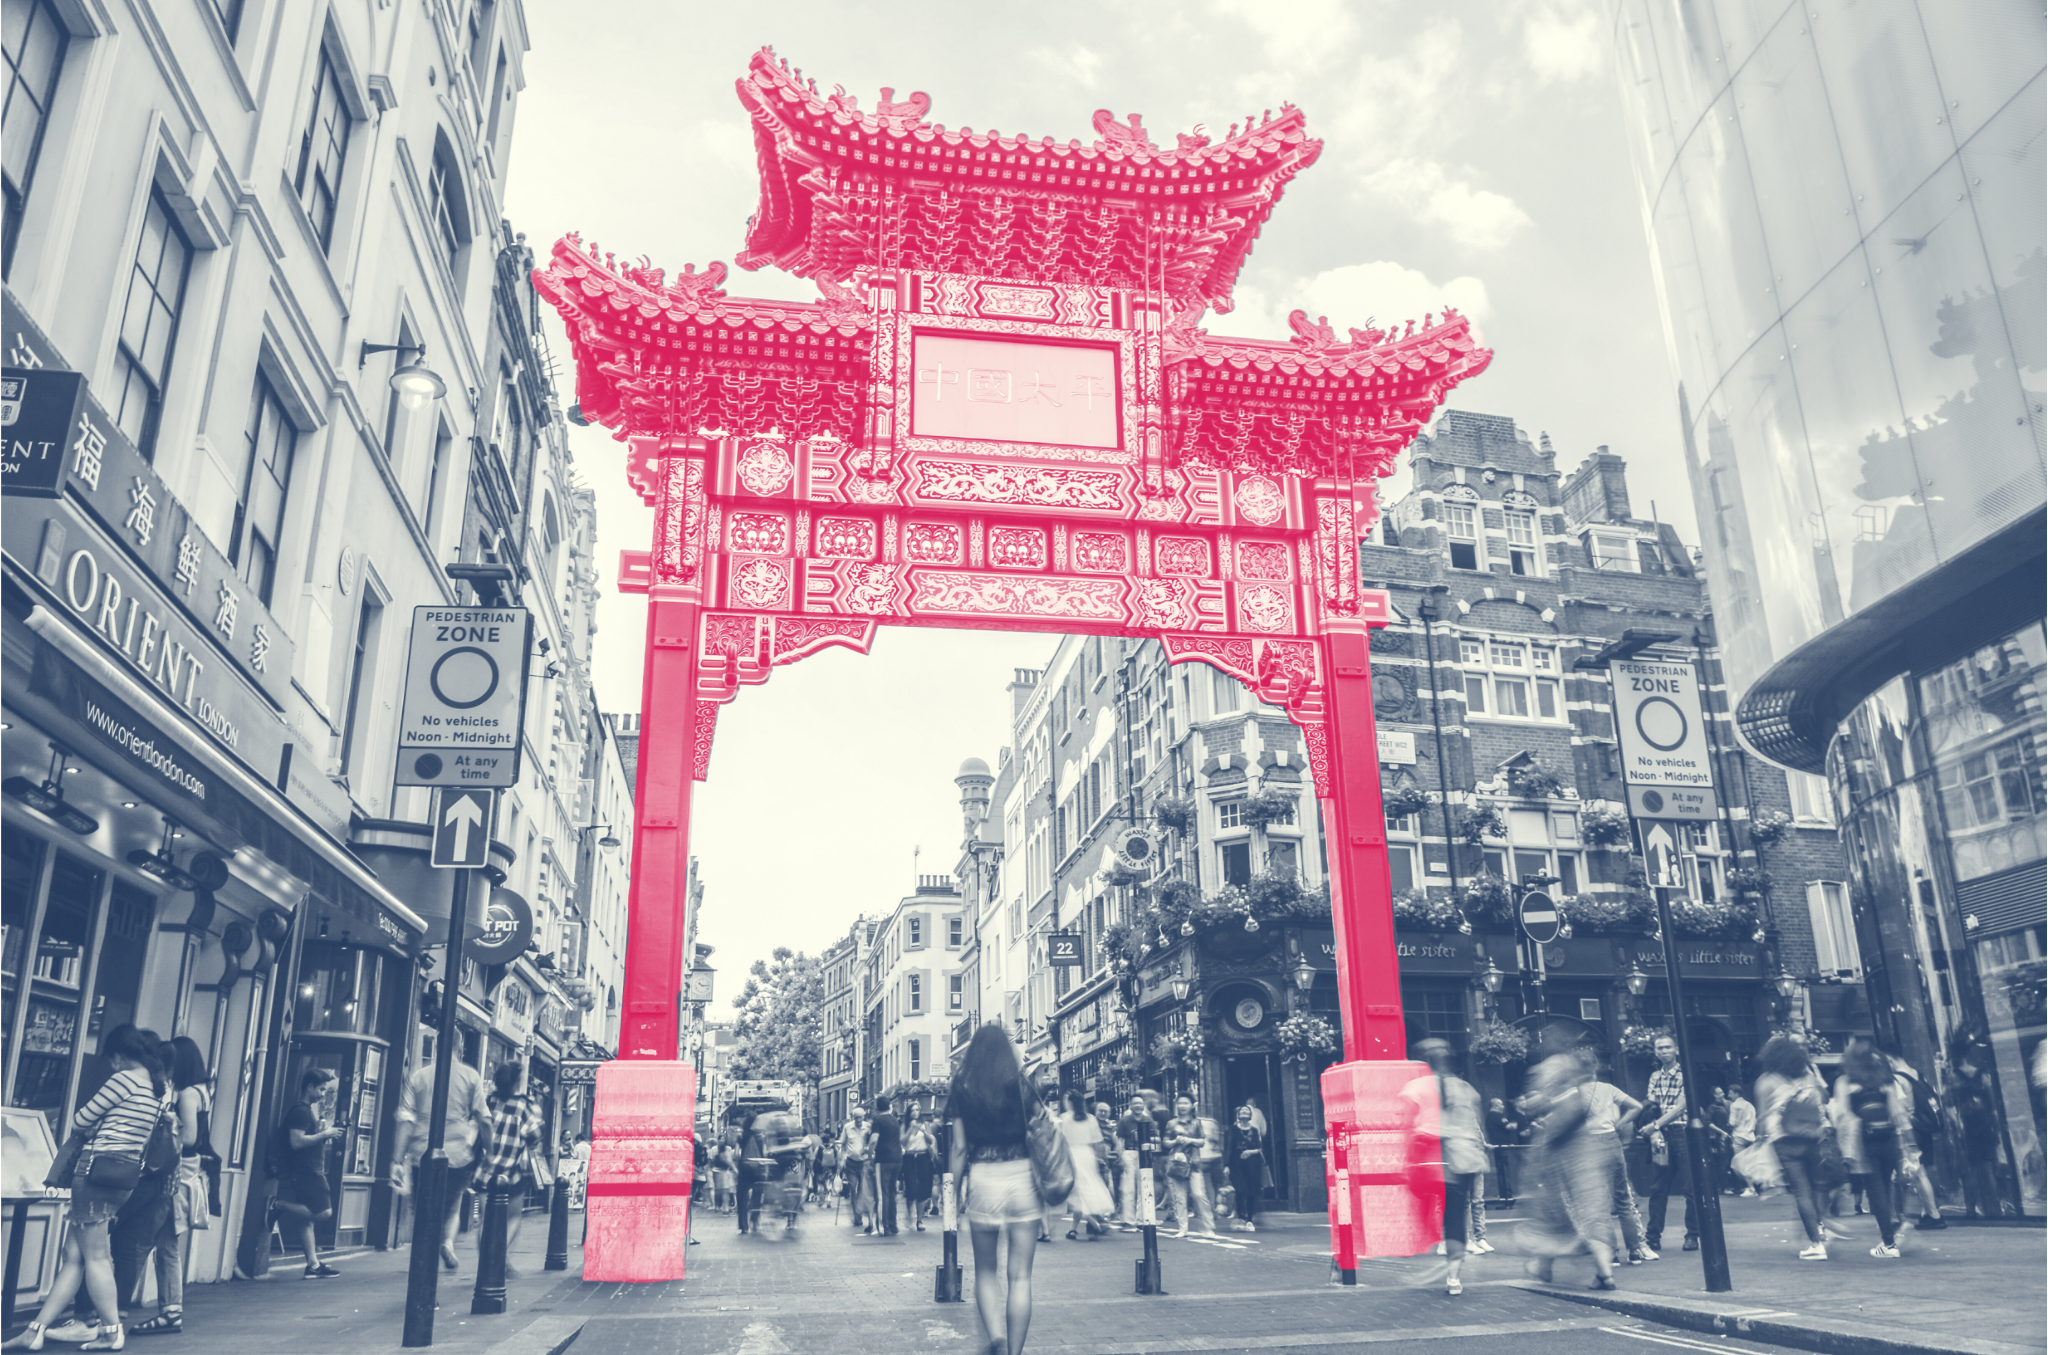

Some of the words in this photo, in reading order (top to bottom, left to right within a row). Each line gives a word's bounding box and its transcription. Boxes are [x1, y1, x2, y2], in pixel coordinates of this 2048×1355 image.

[917, 361, 1112, 412] 中國太平
[426, 611, 516, 623] PEDESTRIAN
[66, 549, 203, 709] ORIENT
[436, 626, 501, 643] ZONE
[1619, 664, 1688, 676] PEDESTRIAN
[1630, 677, 1681, 693] ZONE
[198, 697, 239, 748] LONDON
[422, 715, 441, 726] No
[446, 716, 499, 727] vehicles
[407, 731, 442, 742] Noon
[453, 731, 511, 745] Midnight
[87, 700, 205, 800] www.orientlondon.com
[455, 755, 471, 766] At
[475, 758, 498, 769] any
[1638, 756, 1653, 766] No
[1656, 757, 1696, 768] vehicles
[460, 768, 490, 780] time
[1630, 770, 1656, 781] Noon
[1664, 771, 1709, 784] Midnight
[1672, 792, 1683, 802] At
[1686, 794, 1704, 804] any
[1678, 804, 1701, 814] time
[494, 920, 520, 932] POT
[1056, 941, 1074, 955] 22
